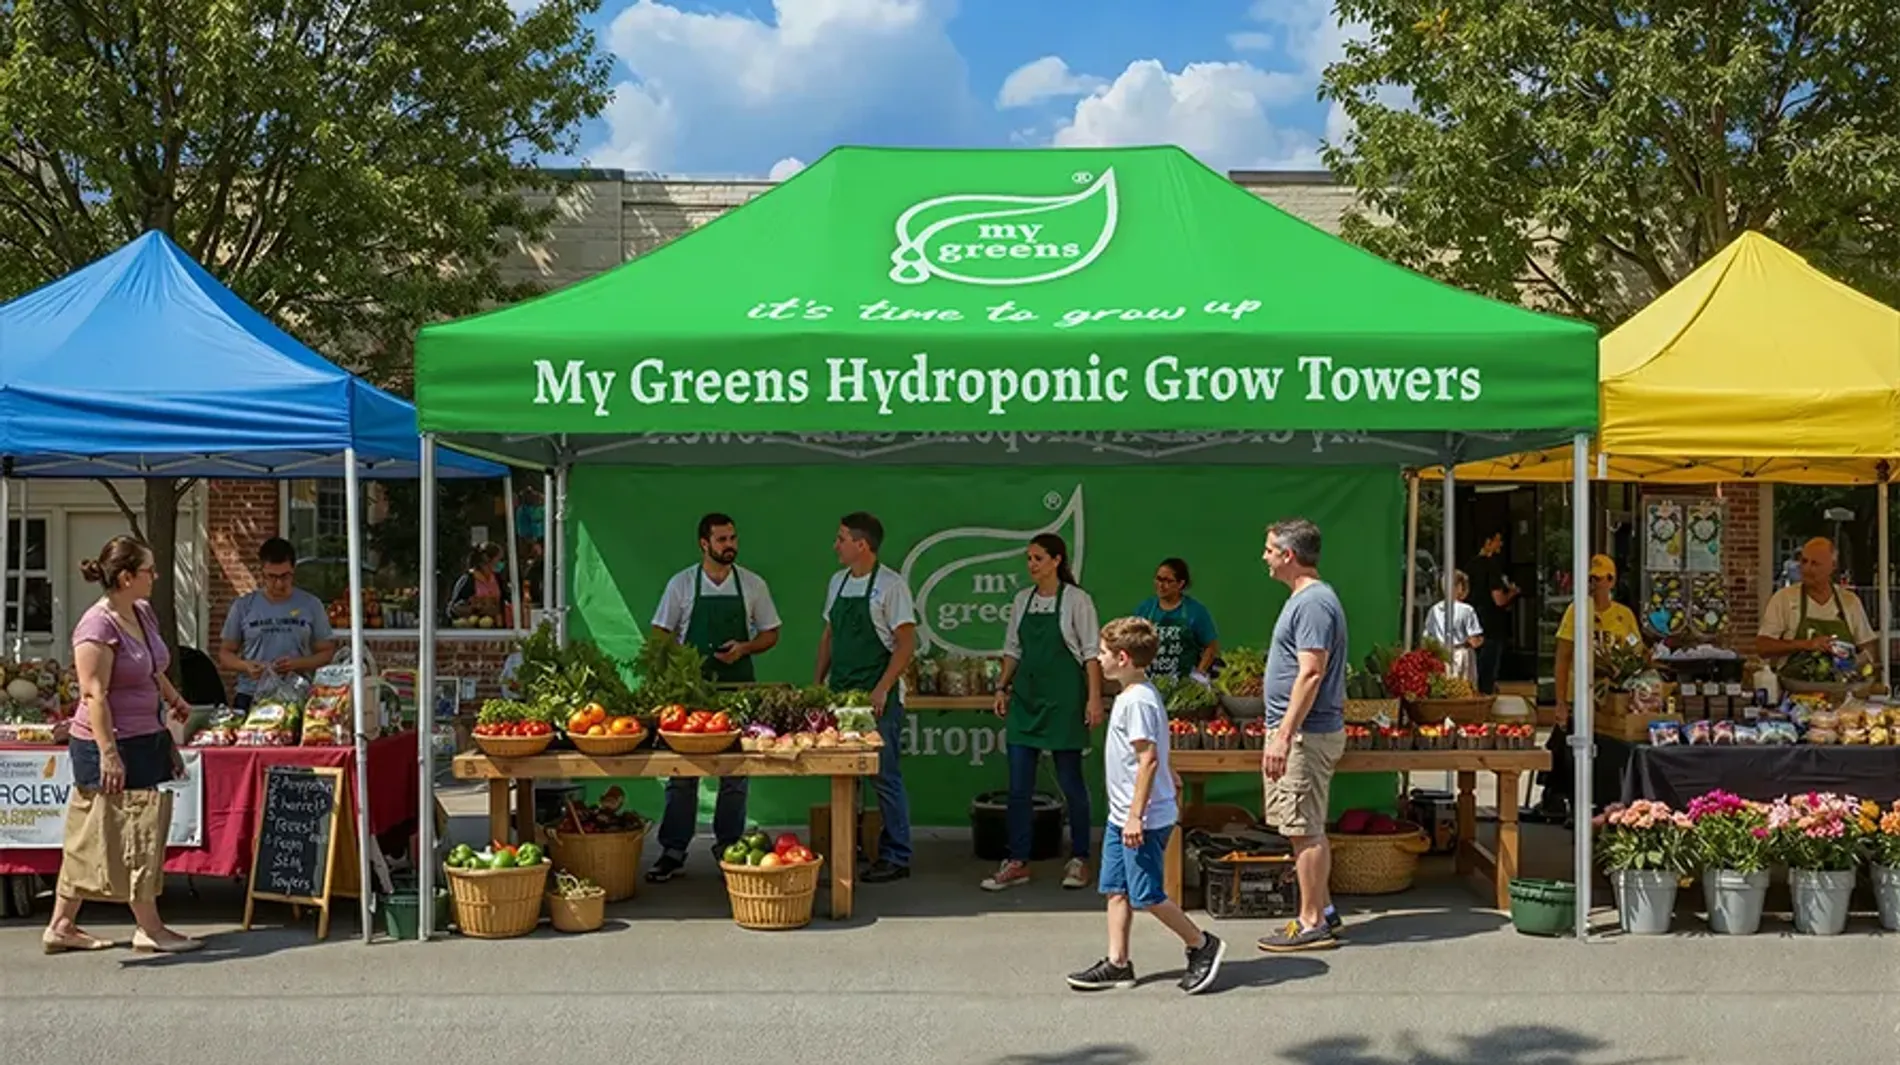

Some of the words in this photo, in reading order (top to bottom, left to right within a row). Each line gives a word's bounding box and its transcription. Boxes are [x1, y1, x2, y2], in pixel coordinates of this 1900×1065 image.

[978, 223, 1044, 244] my
[937, 242, 1081, 263] greens
[746, 297, 834, 320] it's
[986, 300, 1039, 321] to
[1053, 306, 1187, 328] grow
[1203, 299, 1262, 320] up
[533, 358, 617, 417] My
[630, 357, 809, 404] Greens
[825, 352, 1128, 415] Hydroponic
[1144, 355, 1284, 402] Grow
[1298, 355, 1482, 402] Towers
[938, 603, 1013, 630] gree
